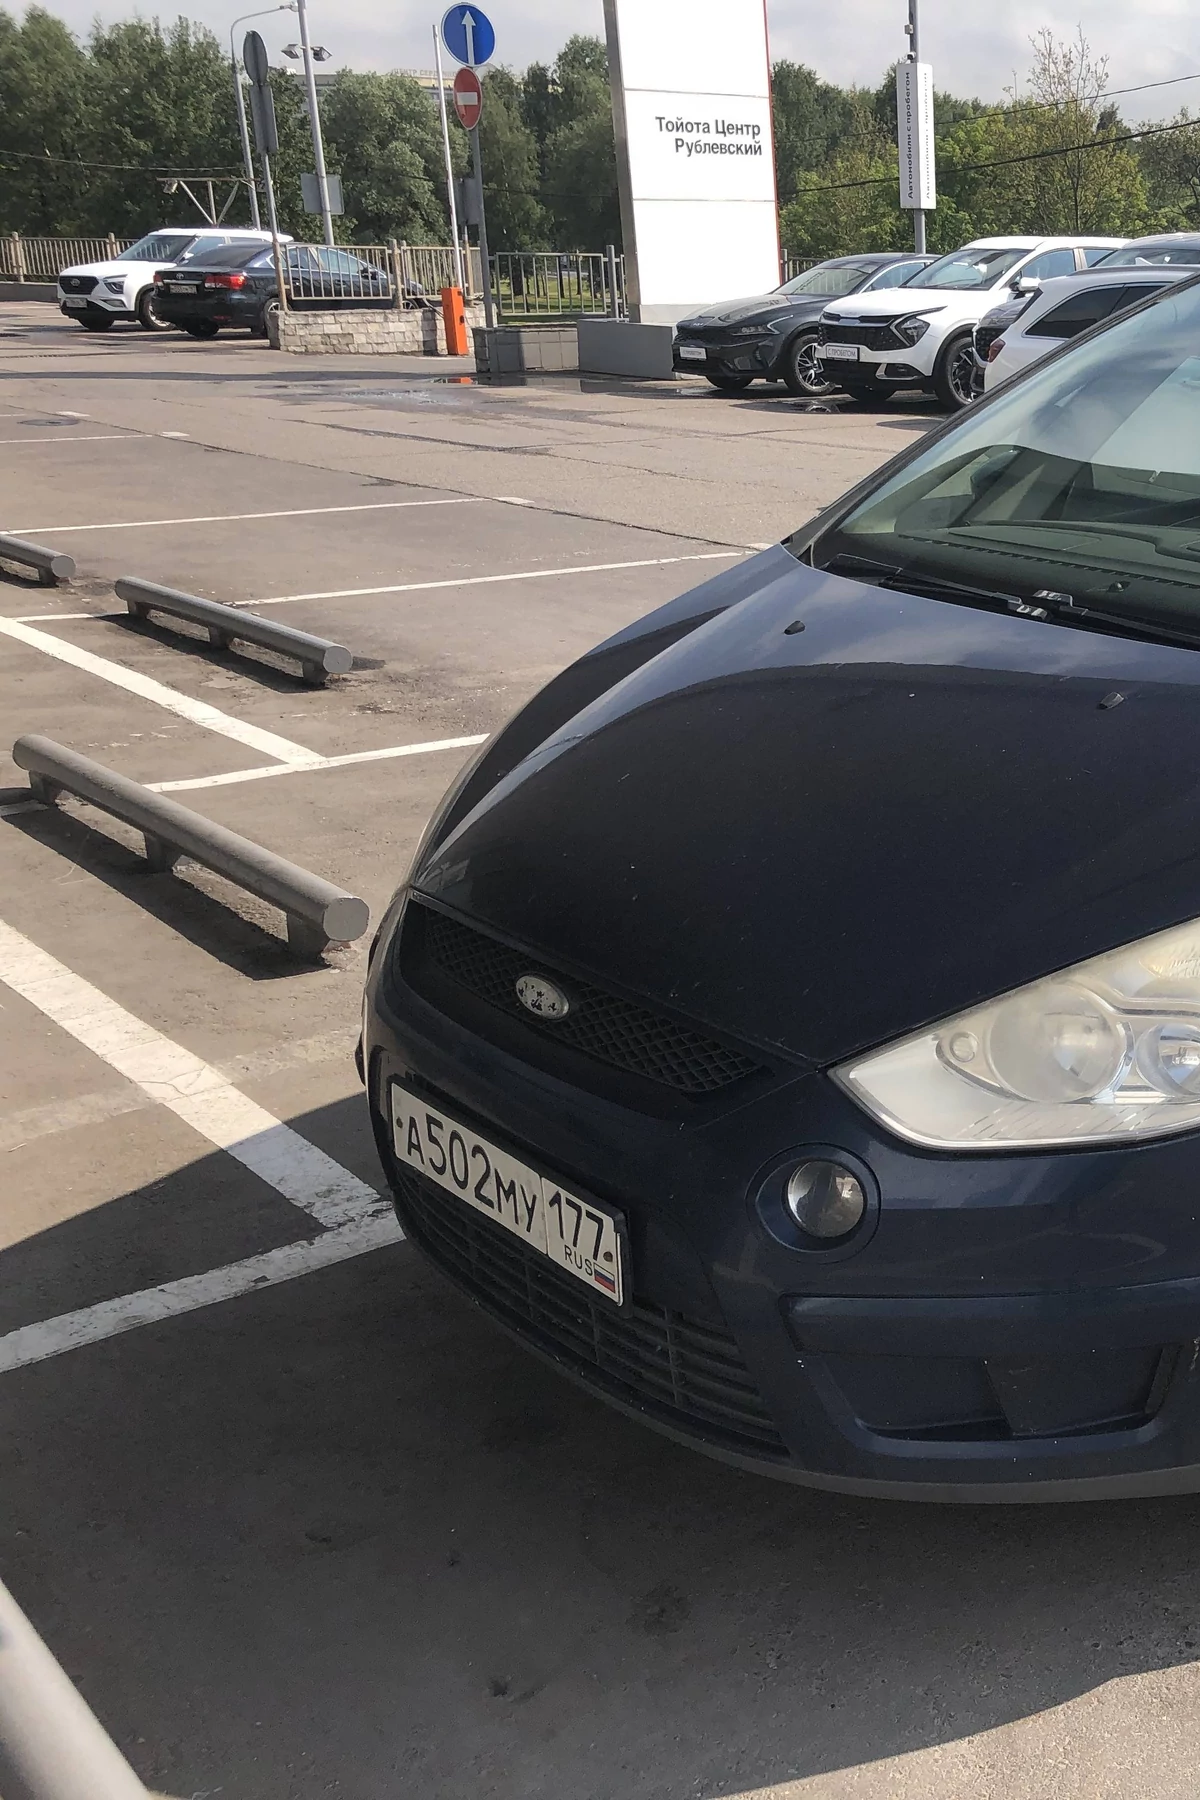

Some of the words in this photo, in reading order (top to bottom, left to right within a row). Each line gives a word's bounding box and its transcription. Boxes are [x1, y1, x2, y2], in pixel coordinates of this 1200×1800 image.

[655, 116, 710, 134] Тойота
[715, 119, 761, 140] Центр
[675, 138, 762, 158] Рублевский
[548, 1190, 605, 1262] 177
[564, 1244, 594, 1277] RUS
